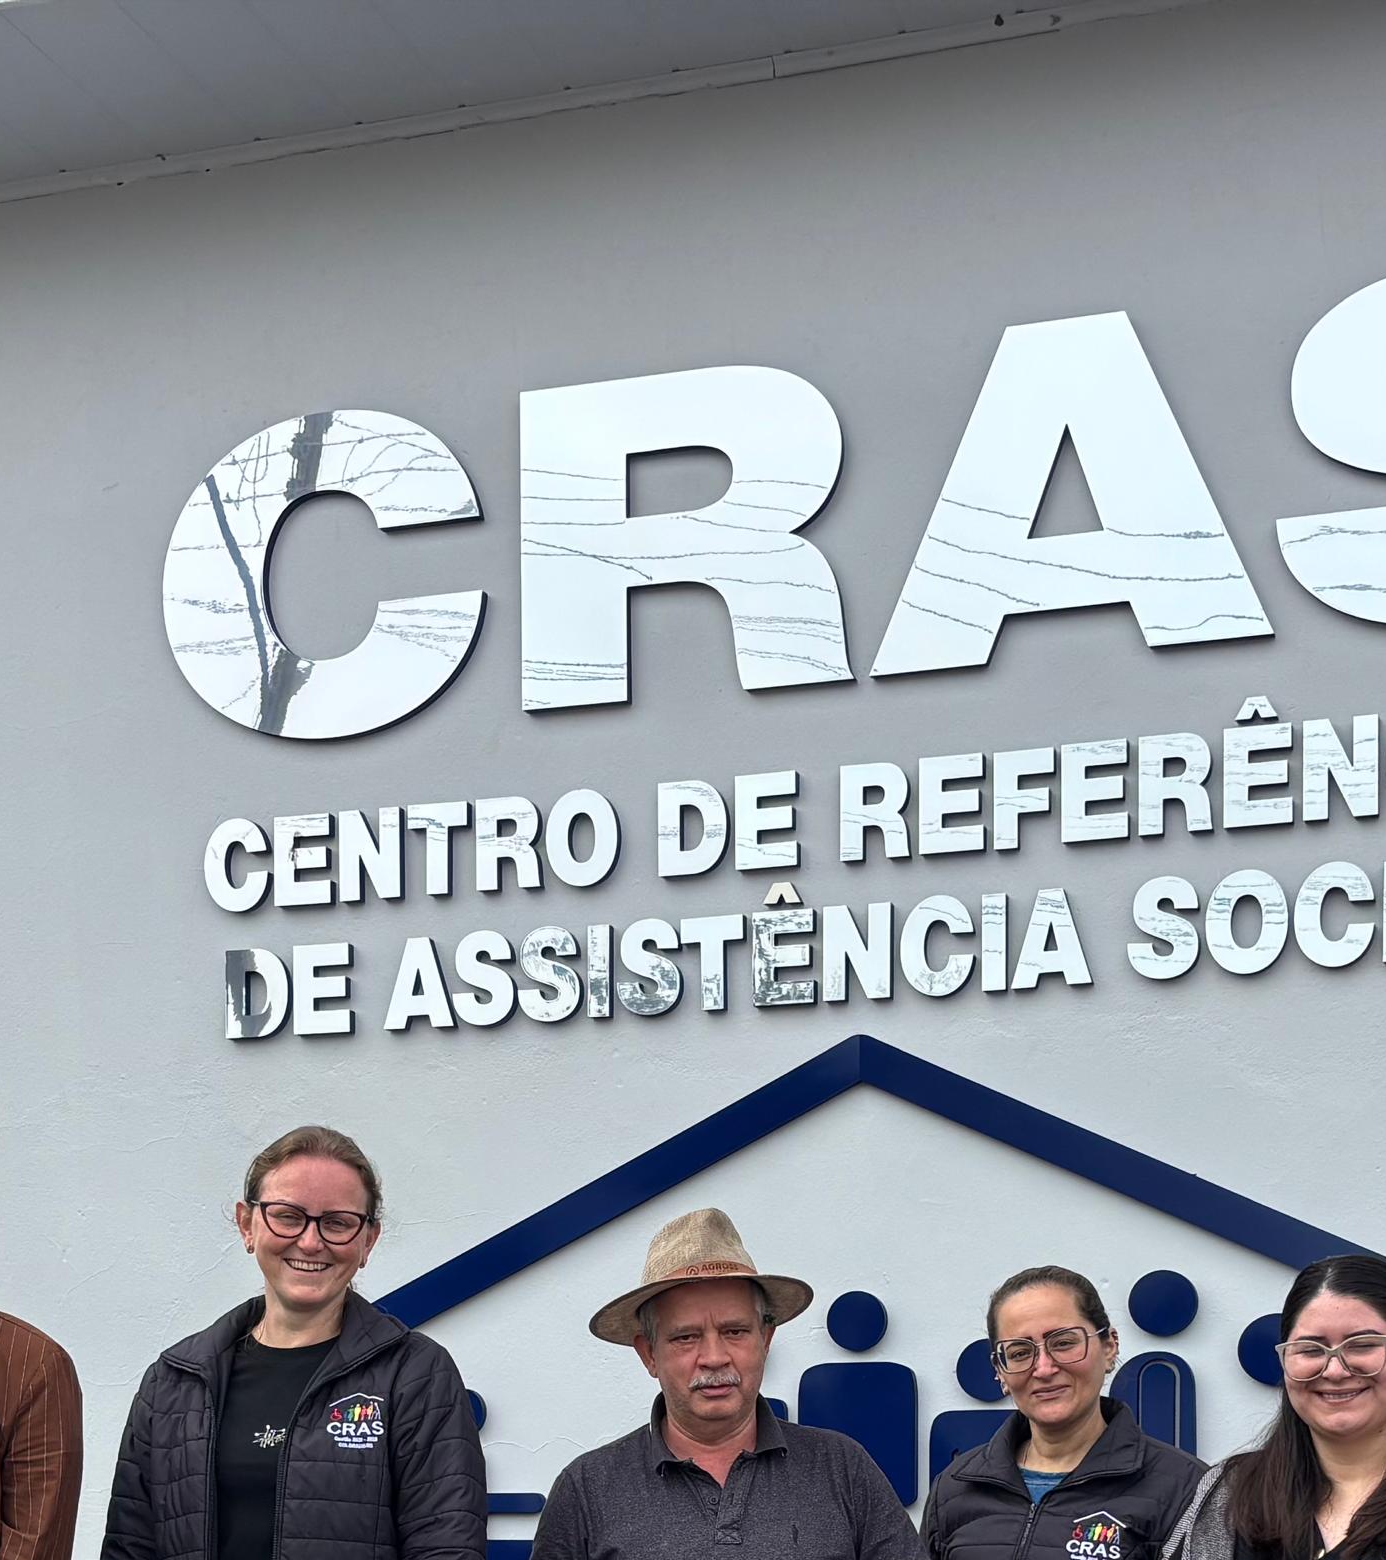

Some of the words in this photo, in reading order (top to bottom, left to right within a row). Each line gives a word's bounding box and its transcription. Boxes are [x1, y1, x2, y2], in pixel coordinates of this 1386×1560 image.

[204, 788, 618, 914] CENTRO
[657, 769, 801, 882] DE
[224, 941, 355, 1039] DE
[383, 880, 1092, 1032] ASSISTÊNCIA
[326, 1420, 385, 1436] CRAS
[1065, 1539, 1121, 1559] CRAS
